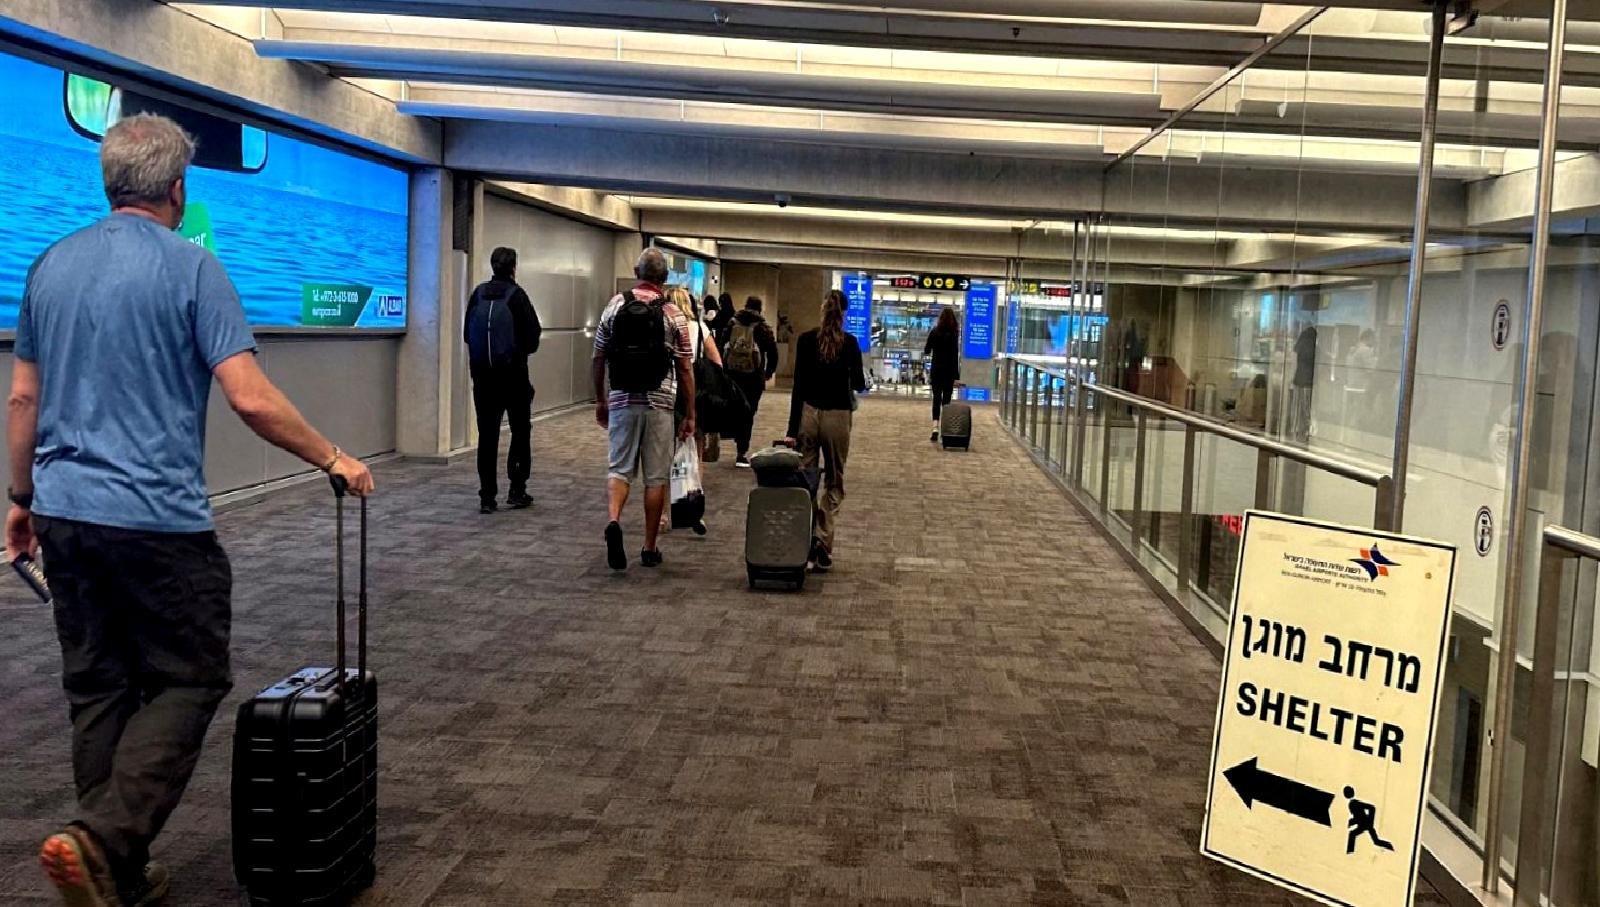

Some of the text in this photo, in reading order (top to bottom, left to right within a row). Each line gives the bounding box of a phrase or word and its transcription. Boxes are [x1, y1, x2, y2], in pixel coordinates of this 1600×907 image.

[1242, 614, 1421, 693] מרחב מוגן
[1236, 682, 1404, 763] SHELTER
